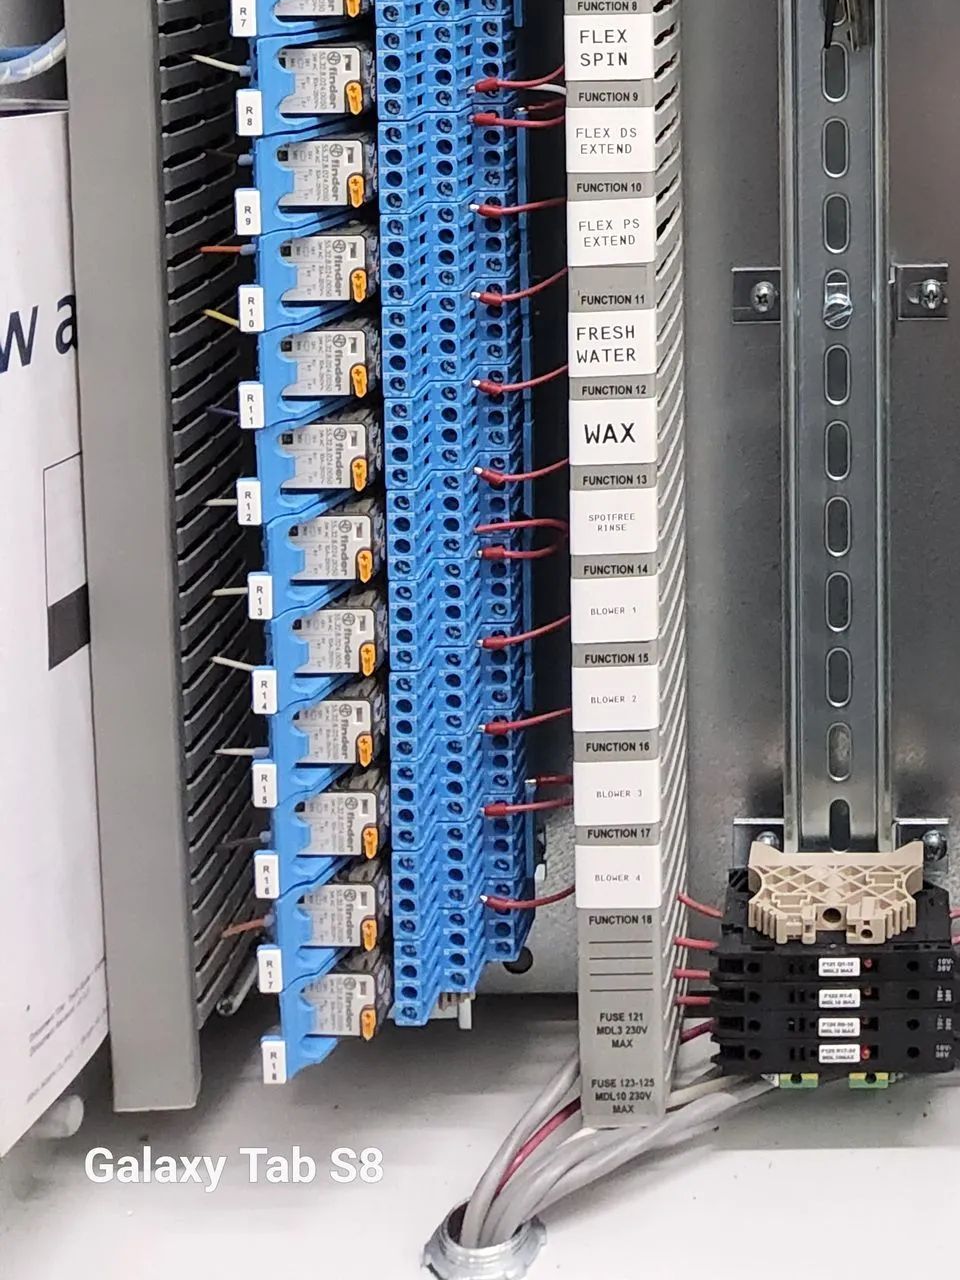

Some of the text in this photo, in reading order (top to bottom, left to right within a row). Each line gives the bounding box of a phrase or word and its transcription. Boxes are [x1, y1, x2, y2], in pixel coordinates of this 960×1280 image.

[577, 1, 638, 11] FUNCTION 8
[580, 29, 627, 44] FLEX
[580, 52, 628, 66] SPIN
[578, 92, 639, 102] FUNCTION 9
[576, 127, 637, 139] FLEX DS
[580, 143, 632, 154] EXTEND
[576, 182, 642, 193] FUNCTION 10
[578, 218, 640, 232] FLEX PS
[584, 234, 635, 247] EXTEND
[581, 294, 645, 305] FUNCTION 11
[576, 325, 635, 341] FRESH
[576, 347, 636, 364] WATER
[334, 349, 342, 391] finder
[582, 385, 646, 395] FUNCTION 12
[584, 422, 636, 444] WAX
[583, 474, 647, 486] FUNCTION 13
[588, 513, 636, 522] SPOTFREE
[597, 524, 627, 532] RINSE
[340, 534, 348, 577] finder
[583, 564, 648, 575] FUNCTION 14
[590, 607, 625, 616] BLOWER
[585, 653, 649, 664] FUNCTION 15
[590, 695, 637, 704] BLOWER 2
[586, 741, 650, 752] FUNCTION 16
[596, 790, 631, 798] BLOWER
[587, 828, 651, 839] FUNCTION 17
[594, 874, 629, 882] BLOWER
[588, 915, 652, 925] FUNCTION 18
[599, 1012, 643, 1022] FUSE 121
[596, 1025, 648, 1035] MDL3 230V
[612, 1039, 633, 1048] MAX
[591, 1078, 655, 1088] FUSE 123-125
[595, 1091, 652, 1101] MDL10 230V
[612, 1104, 634, 1114] MAX
